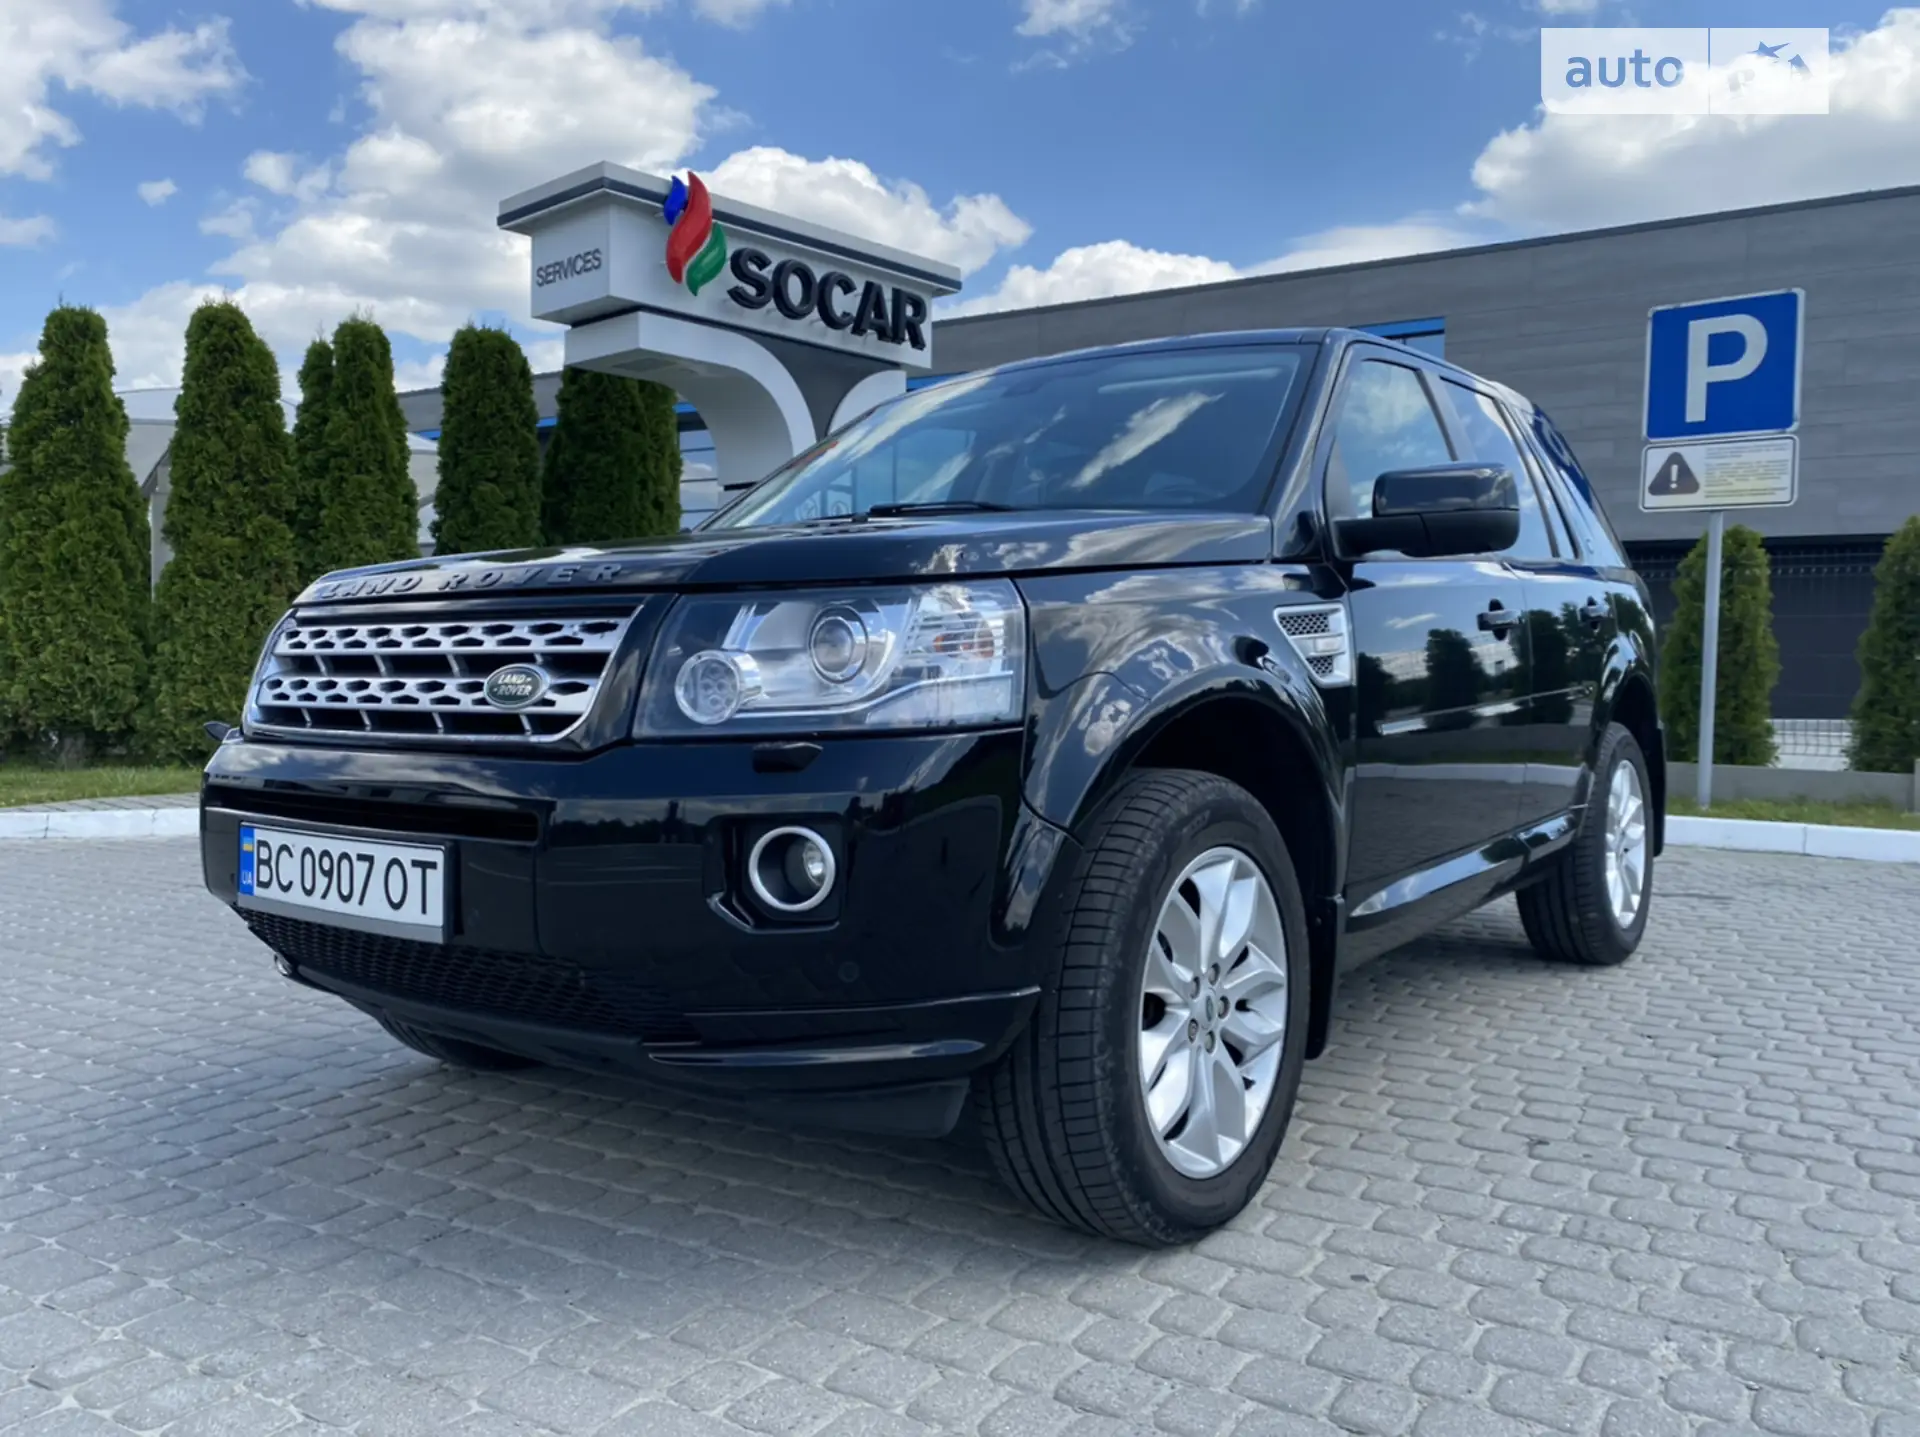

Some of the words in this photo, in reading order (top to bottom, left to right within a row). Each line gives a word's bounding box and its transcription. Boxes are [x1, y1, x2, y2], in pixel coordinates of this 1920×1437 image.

[536, 248, 602, 287] SERVICES
[727, 247, 926, 351] SOCAR
[1685, 313, 1768, 423] P
[319, 574, 422, 600] LAND
[438, 562, 622, 591] ROVER
